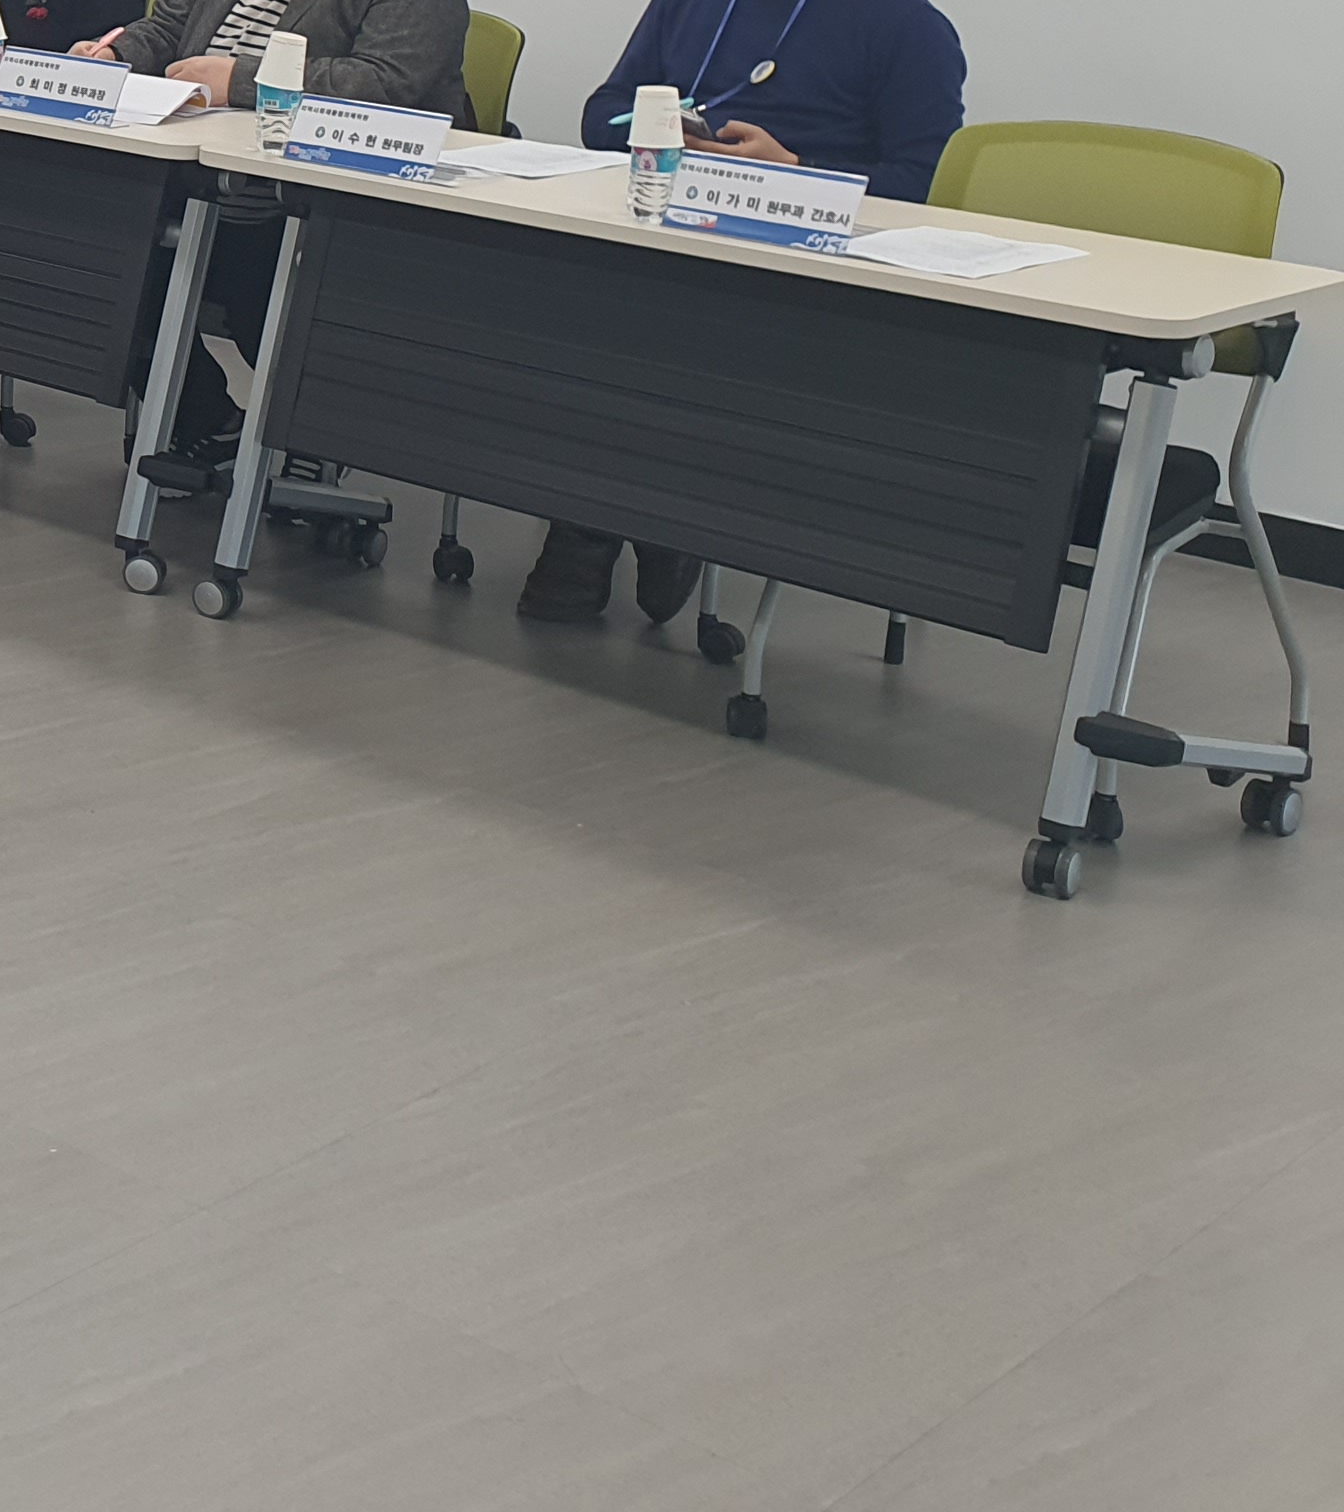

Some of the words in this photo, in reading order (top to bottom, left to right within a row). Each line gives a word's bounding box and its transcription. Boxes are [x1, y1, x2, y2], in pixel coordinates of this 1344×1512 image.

[71, 86, 106, 100] 원무과장
[382, 138, 425, 156] 원무팀장
[767, 200, 805, 219] 원무과
[811, 207, 850, 227] 간호사
